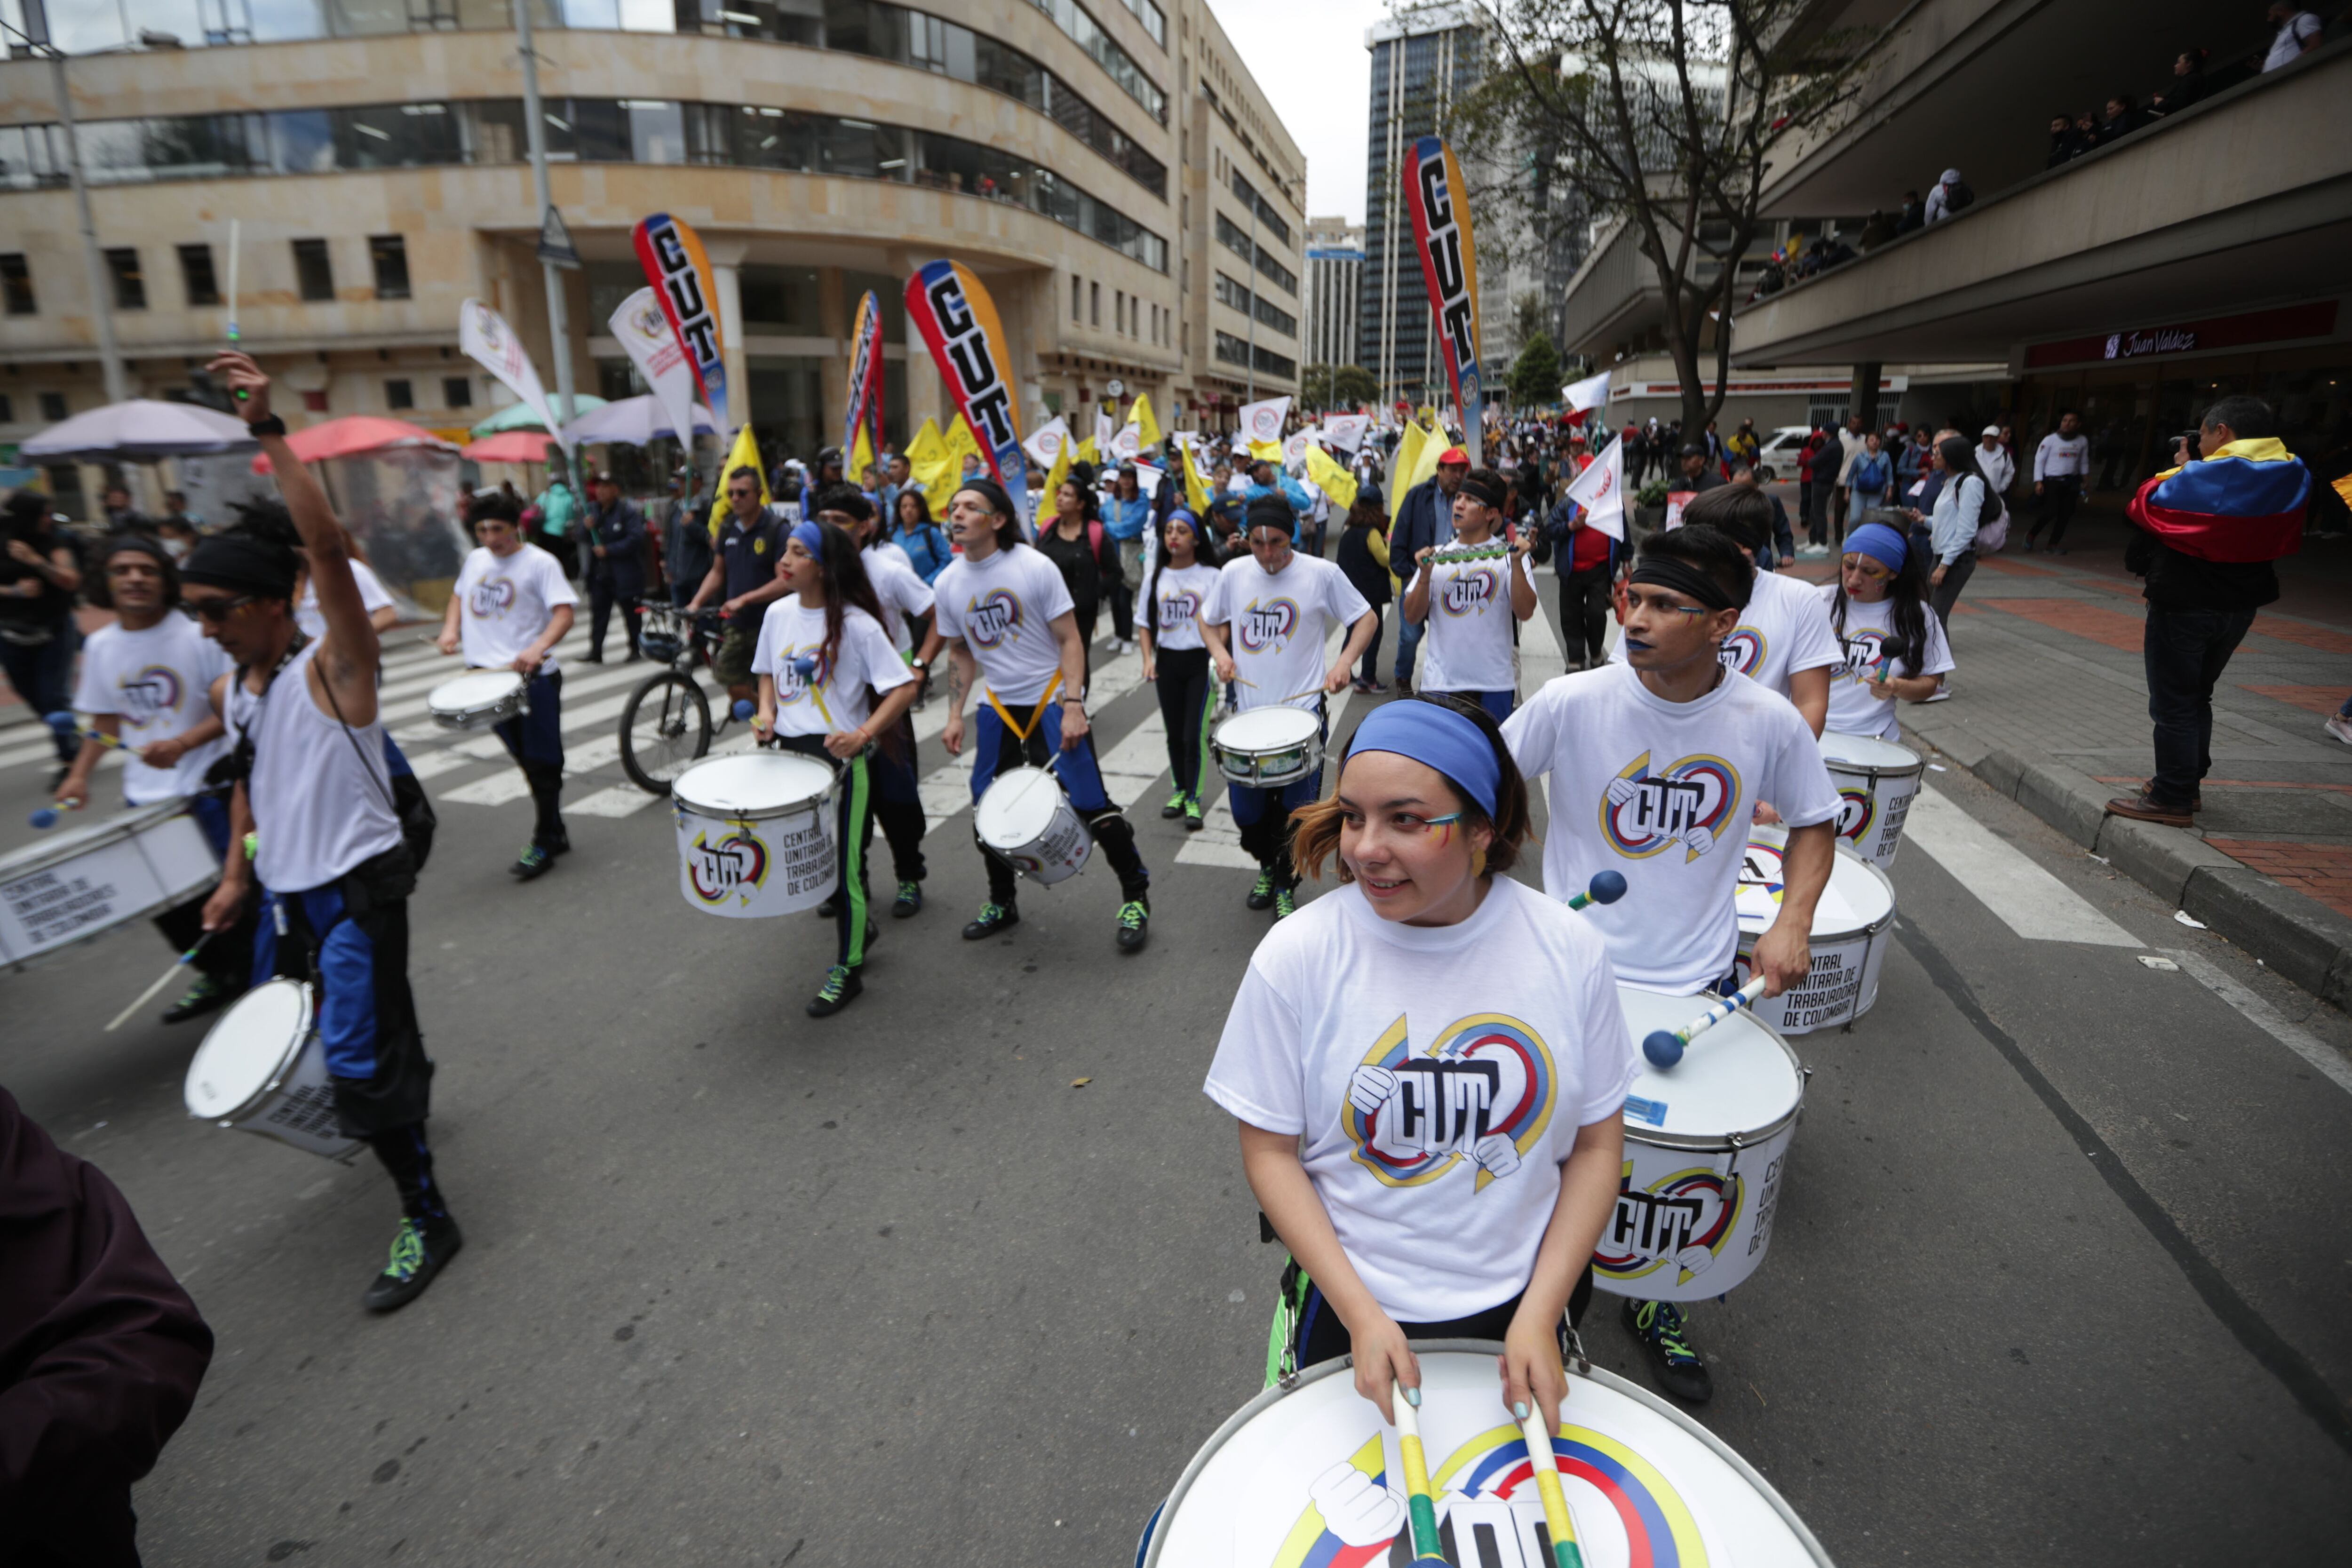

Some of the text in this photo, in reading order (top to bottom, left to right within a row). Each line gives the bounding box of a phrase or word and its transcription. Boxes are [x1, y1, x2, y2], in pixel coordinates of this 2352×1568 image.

[1420, 154, 1472, 370] CUT
[650, 224, 717, 366] CUT
[2123, 329, 2194, 357] Juan Valdez
[929, 275, 1012, 448] CUT
[1454, 579, 1482, 605] CUT
[1252, 611, 1281, 642] CUT
[1630, 778, 1704, 838] CUT
[784, 825, 822, 848] CENTRAL
[785, 838, 826, 864] UNITARIA
[702, 849, 742, 889] CUT
[787, 881, 800, 896] DE
[1789, 966, 1857, 991] NITARIA DE
[1783, 999, 1850, 1027] DE COLOMBIA
[1392, 1059, 1499, 1154] CUT
[1605, 1191, 1702, 1260] CUT
